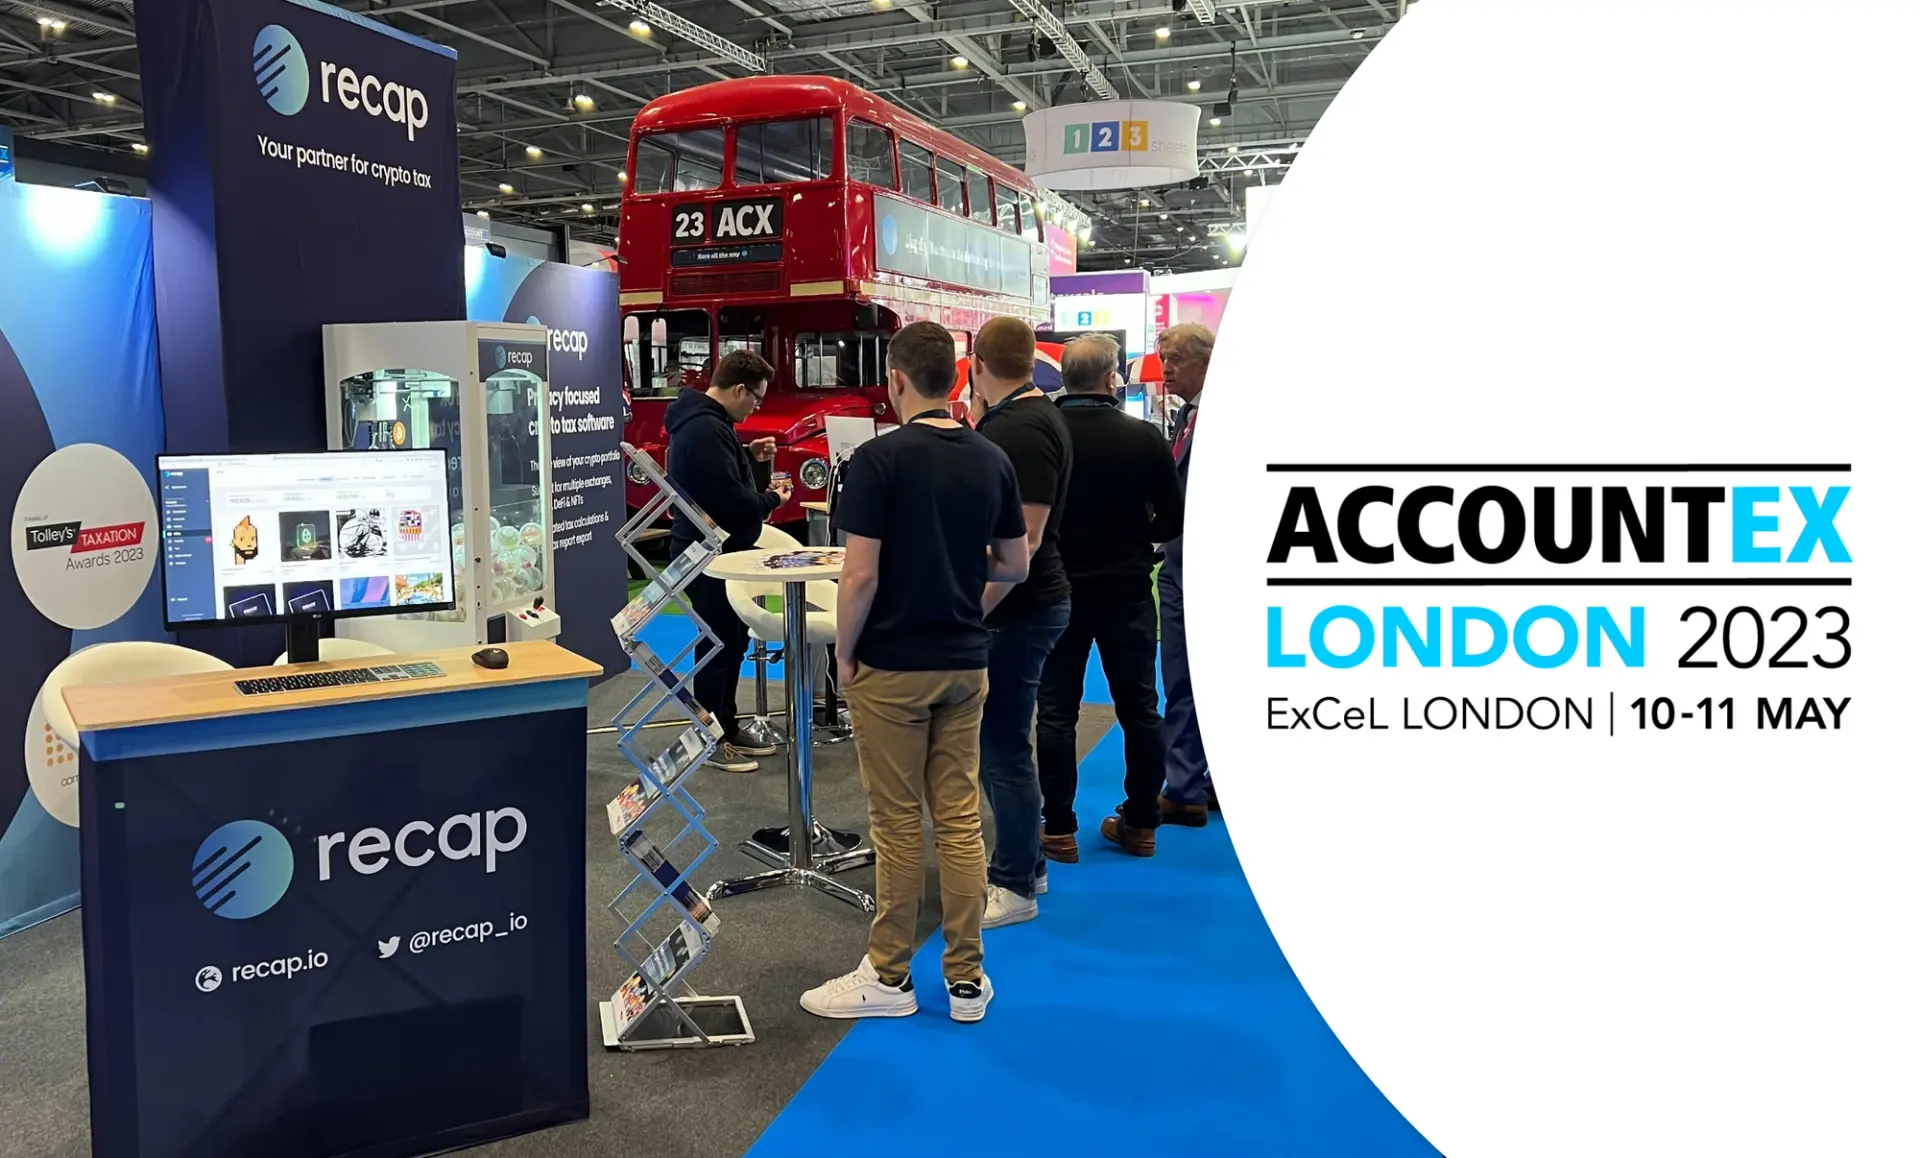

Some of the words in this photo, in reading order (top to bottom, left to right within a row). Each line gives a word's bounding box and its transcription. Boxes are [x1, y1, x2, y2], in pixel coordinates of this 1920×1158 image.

[320, 61, 429, 142] recap
[1151, 139, 1189, 155] sheets
[257, 134, 294, 161] Your
[296, 146, 349, 171] partner
[350, 154, 370, 175] for
[371, 162, 412, 187] crypto
[412, 169, 432, 188] tax
[675, 211, 704, 238] 23
[716, 204, 775, 237] ACX
[547, 328, 588, 361] recap
[507, 351, 533, 368] recap
[565, 386, 600, 405] focused
[561, 415, 578, 434] tax
[577, 412, 615, 433] software
[553, 457, 566, 469] view
[572, 455, 584, 470] your
[584, 453, 601, 468] crypto
[600, 449, 621, 466] portfolio
[563, 477, 584, 493] multiple
[565, 520, 574, 531] tax
[574, 513, 604, 529] calculations
[81, 528, 137, 547] TAXATION
[559, 535, 576, 551] report
[575, 531, 593, 546] export
[65, 552, 111, 572] Awards
[114, 547, 144, 564] 2023
[317, 806, 528, 882] recap
[231, 949, 329, 982] recap.io
[408, 912, 528, 954] @recap_io
